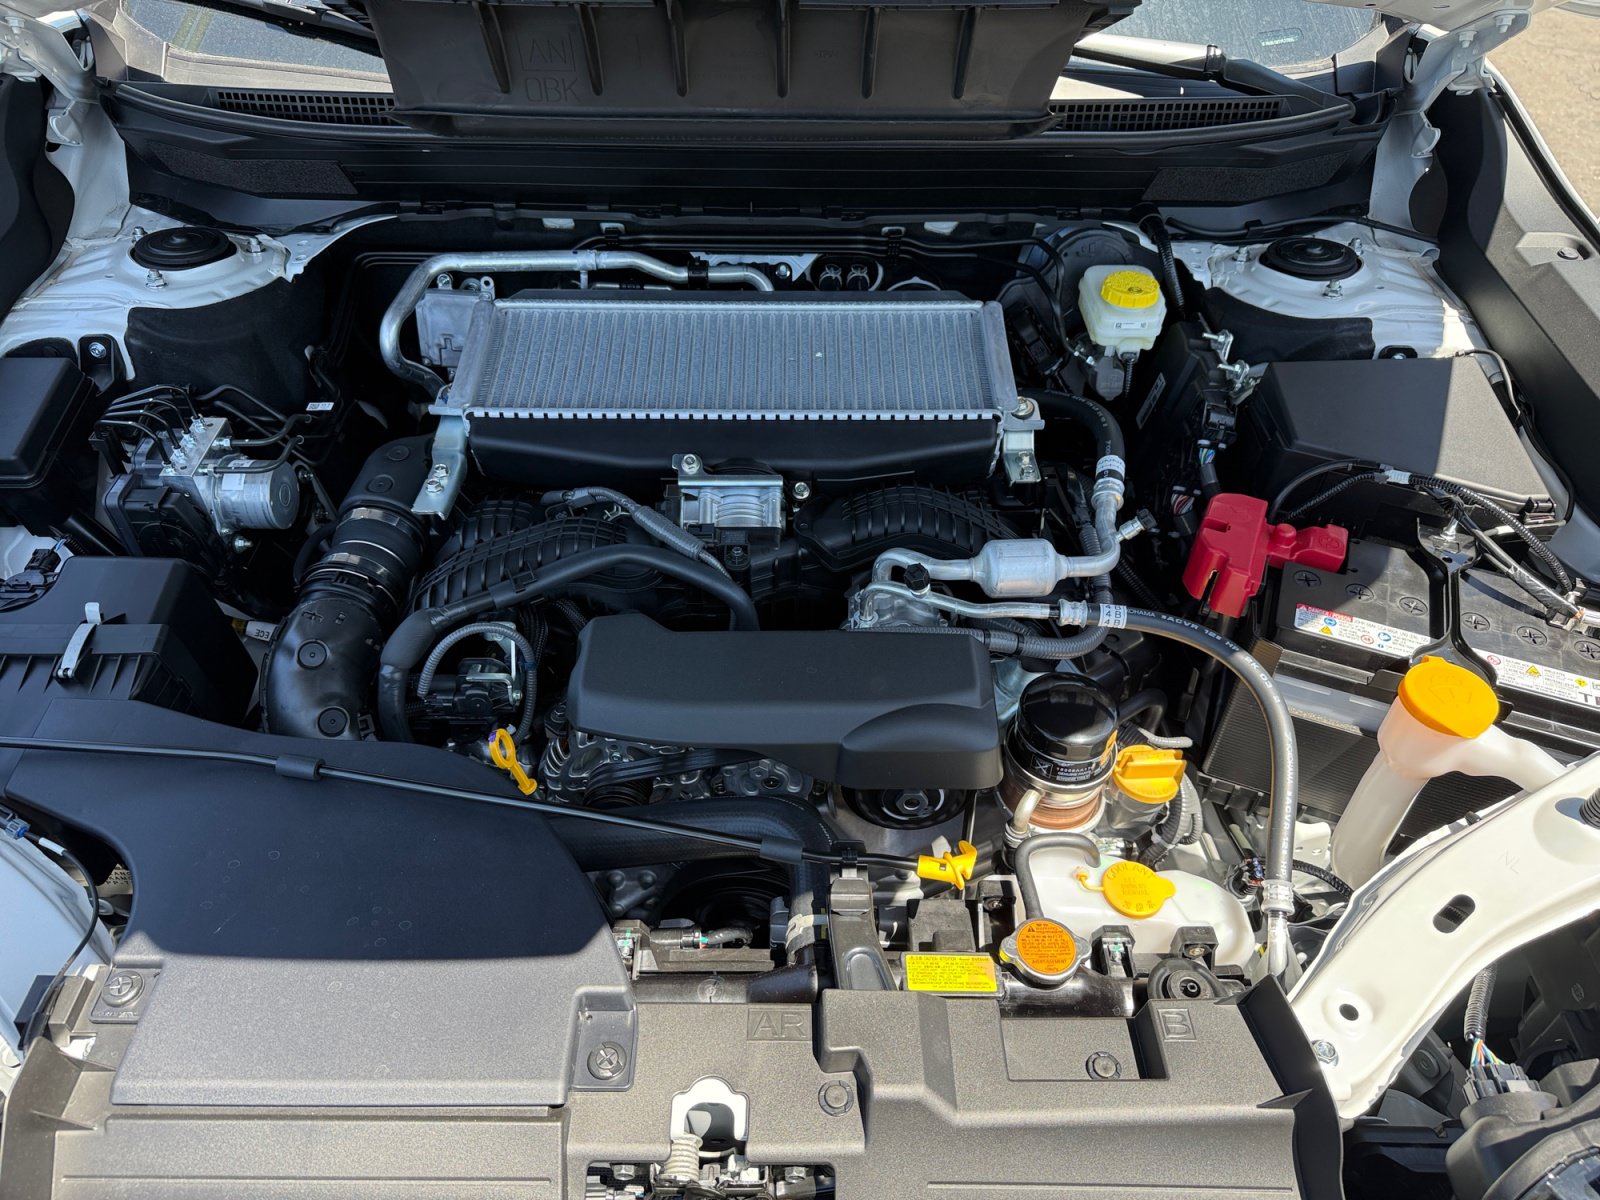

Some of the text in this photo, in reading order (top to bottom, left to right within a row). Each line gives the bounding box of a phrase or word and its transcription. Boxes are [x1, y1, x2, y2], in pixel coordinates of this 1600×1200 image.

[525, 76, 581, 103] OBK
[753, 1011, 807, 1038] AR
[1162, 1013, 1191, 1038] B
